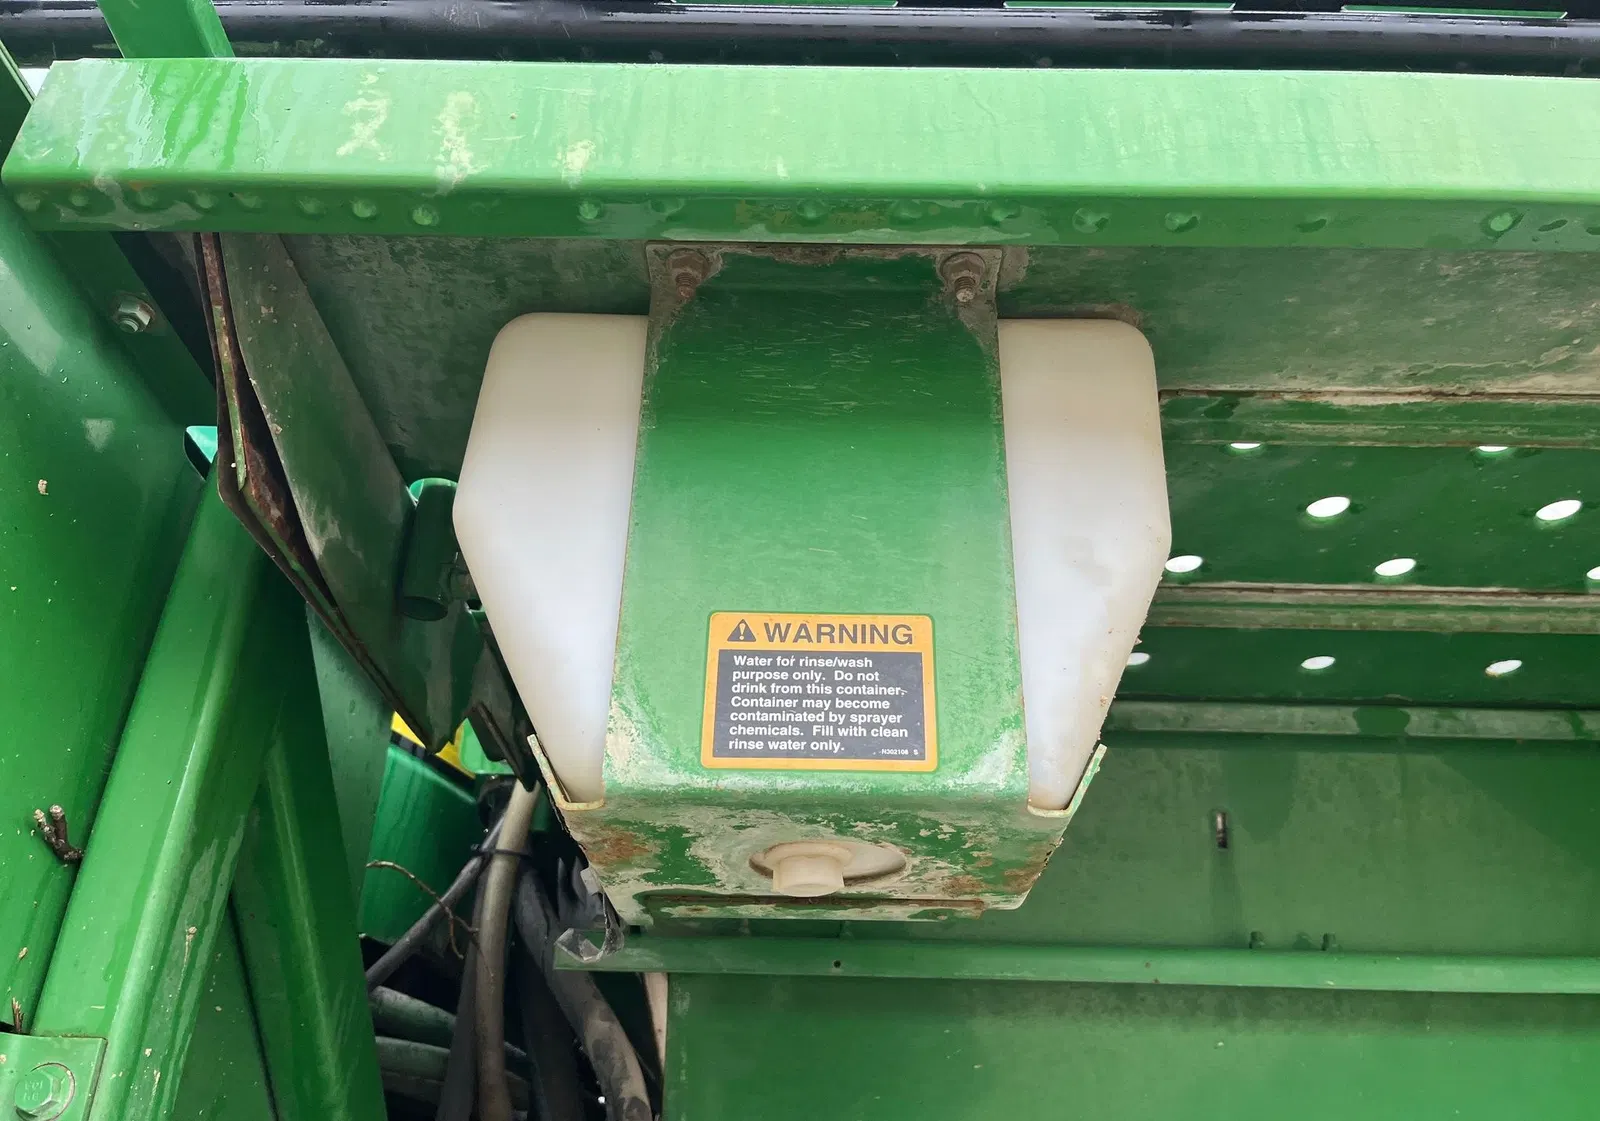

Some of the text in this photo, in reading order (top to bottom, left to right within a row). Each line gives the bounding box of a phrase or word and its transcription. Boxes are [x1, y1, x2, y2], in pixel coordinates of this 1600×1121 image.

[764, 622, 913, 645] WARNING
[734, 655, 873, 668] Water for rinse/wash
[732, 670, 880, 683] purpose only. Do not
[731, 683, 905, 696] drink from this container.
[731, 696, 890, 711] Container may become
[730, 710, 903, 725] contaminated by sprayer
[729, 724, 908, 738] chemicals. Fill with clean
[728, 738, 845, 753] rinse water only.
